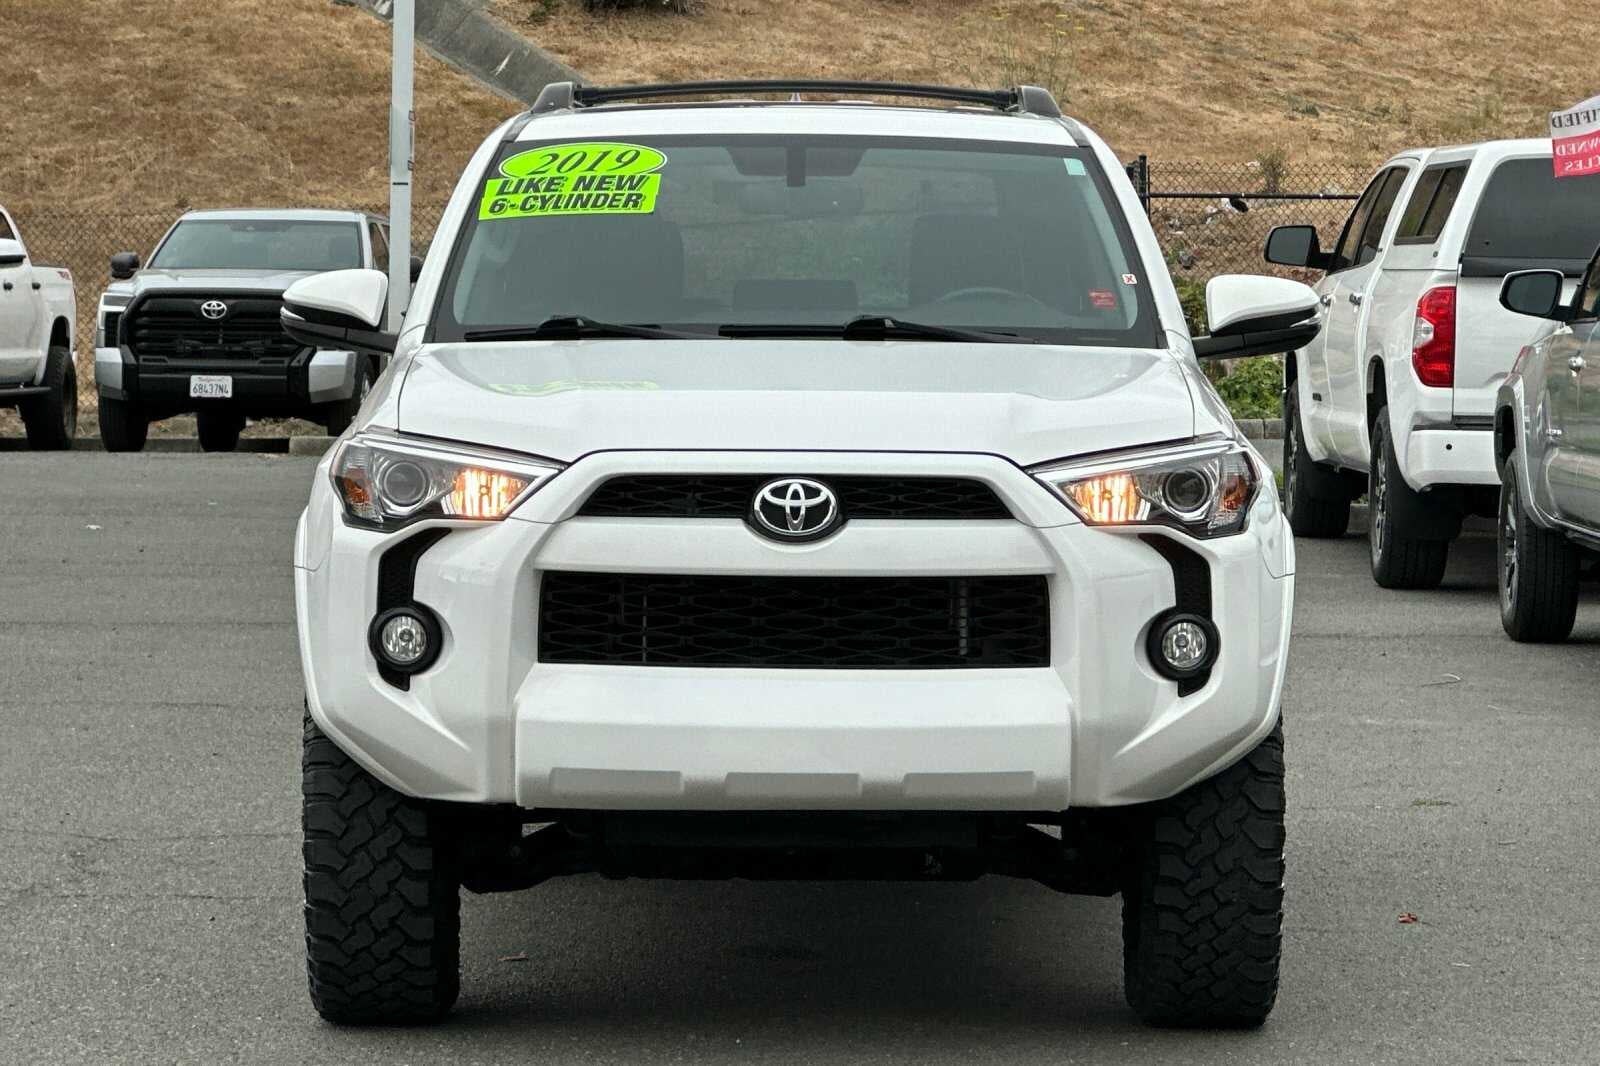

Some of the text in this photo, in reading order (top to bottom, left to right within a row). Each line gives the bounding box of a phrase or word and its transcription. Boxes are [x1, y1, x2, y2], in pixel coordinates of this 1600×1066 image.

[528, 149, 641, 175] 2019
[496, 174, 650, 195] LIKE NEW
[489, 193, 646, 214] 6-CYLINDER
